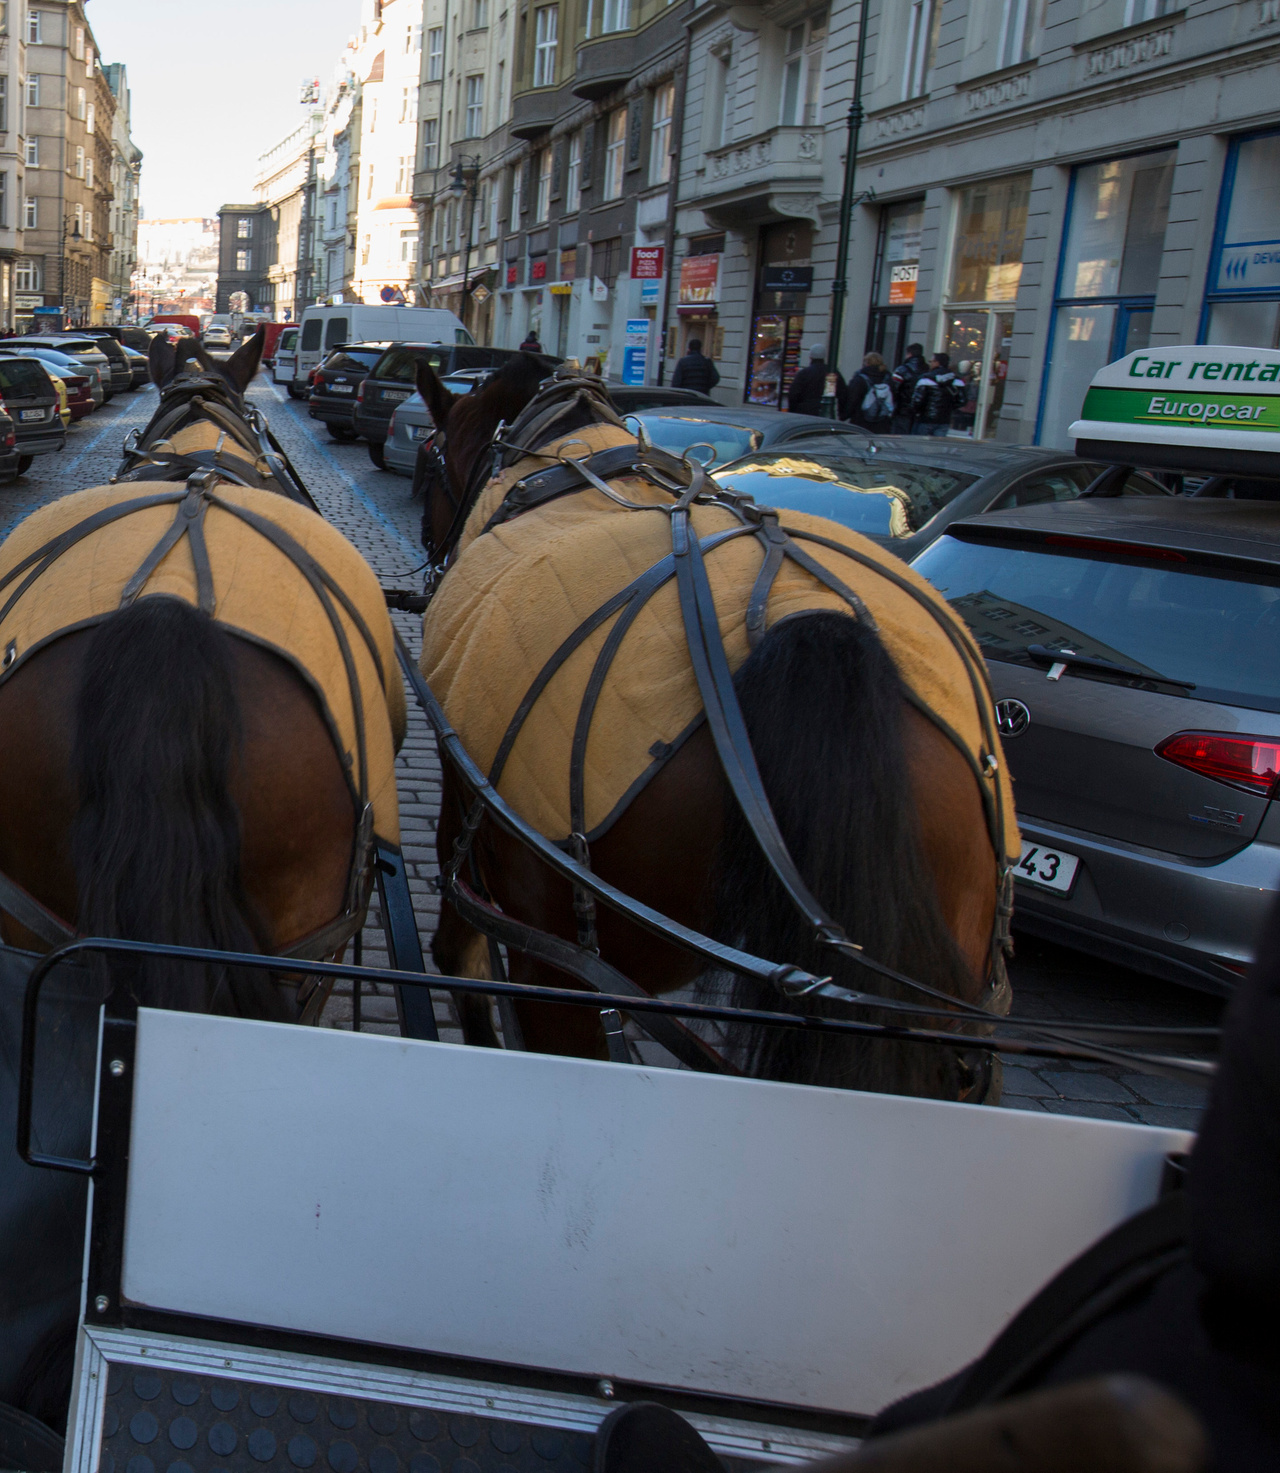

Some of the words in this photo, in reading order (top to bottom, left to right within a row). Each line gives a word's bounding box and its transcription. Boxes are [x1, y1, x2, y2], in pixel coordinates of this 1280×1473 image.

[637, 250, 659, 258] food
[893, 266, 918, 281] HOST
[1129, 356, 1181, 379] Car
[1187, 359, 1280, 382] renta
[1146, 396, 1267, 423] Europcar
[1019, 847, 1062, 882] 43
